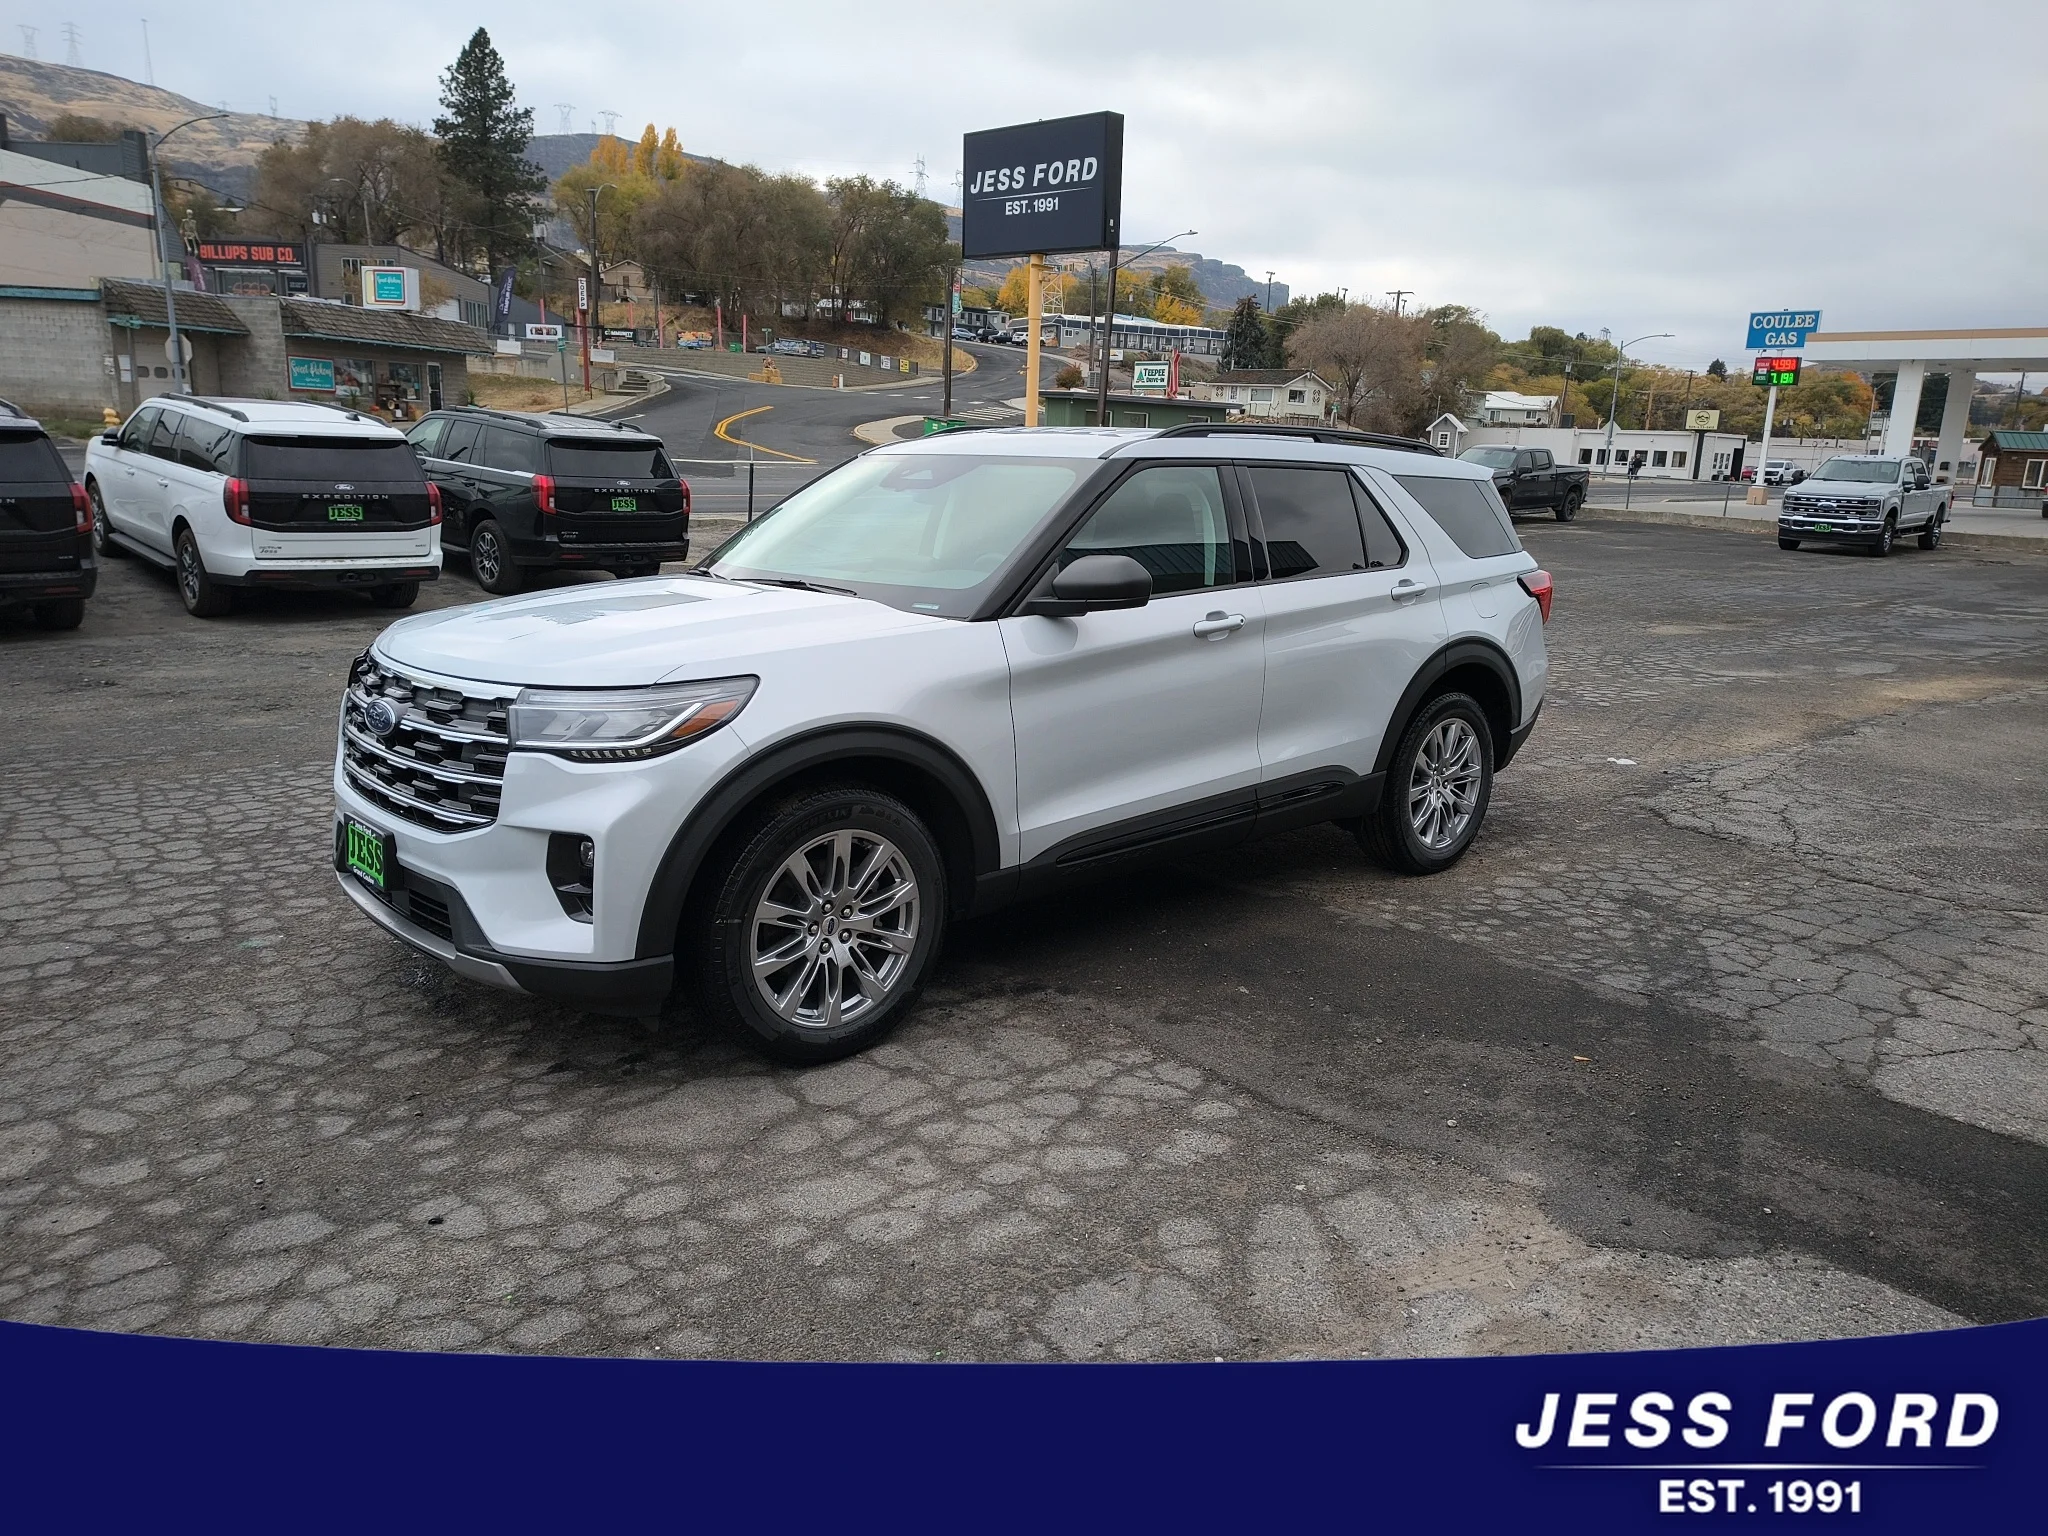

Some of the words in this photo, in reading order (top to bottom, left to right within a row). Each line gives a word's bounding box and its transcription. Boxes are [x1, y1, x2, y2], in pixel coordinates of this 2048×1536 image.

[970, 165, 1026, 194] JESS
[1033, 156, 1098, 187] FORD
[1005, 200, 1031, 216] EST.
[1033, 197, 1059, 213] 1991
[200, 244, 248, 260] BILLUPS
[251, 246, 274, 261] SUB
[277, 247, 297, 262] CO.
[1752, 314, 1816, 329] COULEE
[1764, 331, 1798, 346] GAS
[1143, 368, 1166, 377] TEEPEE
[613, 499, 634, 509] JESS
[330, 507, 360, 518] JESS
[350, 827, 383, 877] JESS
